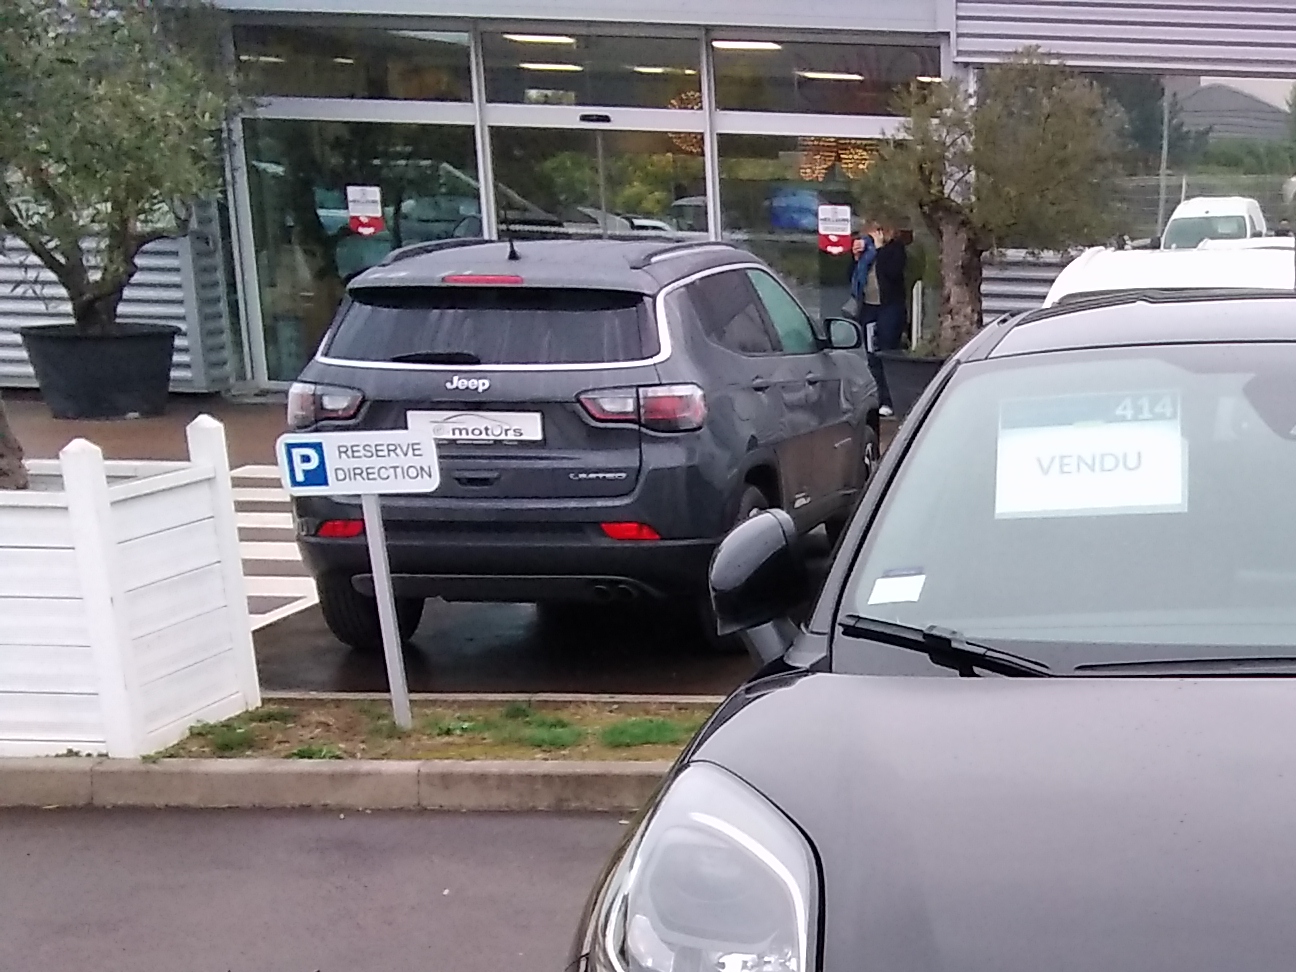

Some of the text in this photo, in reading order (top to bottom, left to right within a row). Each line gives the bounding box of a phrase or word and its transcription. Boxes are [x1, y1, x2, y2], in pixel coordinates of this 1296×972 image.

[445, 375, 490, 392] Jeep
[1116, 396, 1173, 420] 414
[337, 442, 423, 459] RESERVE
[1036, 450, 1142, 477] VENDU
[334, 465, 433, 482] DIRECTION
